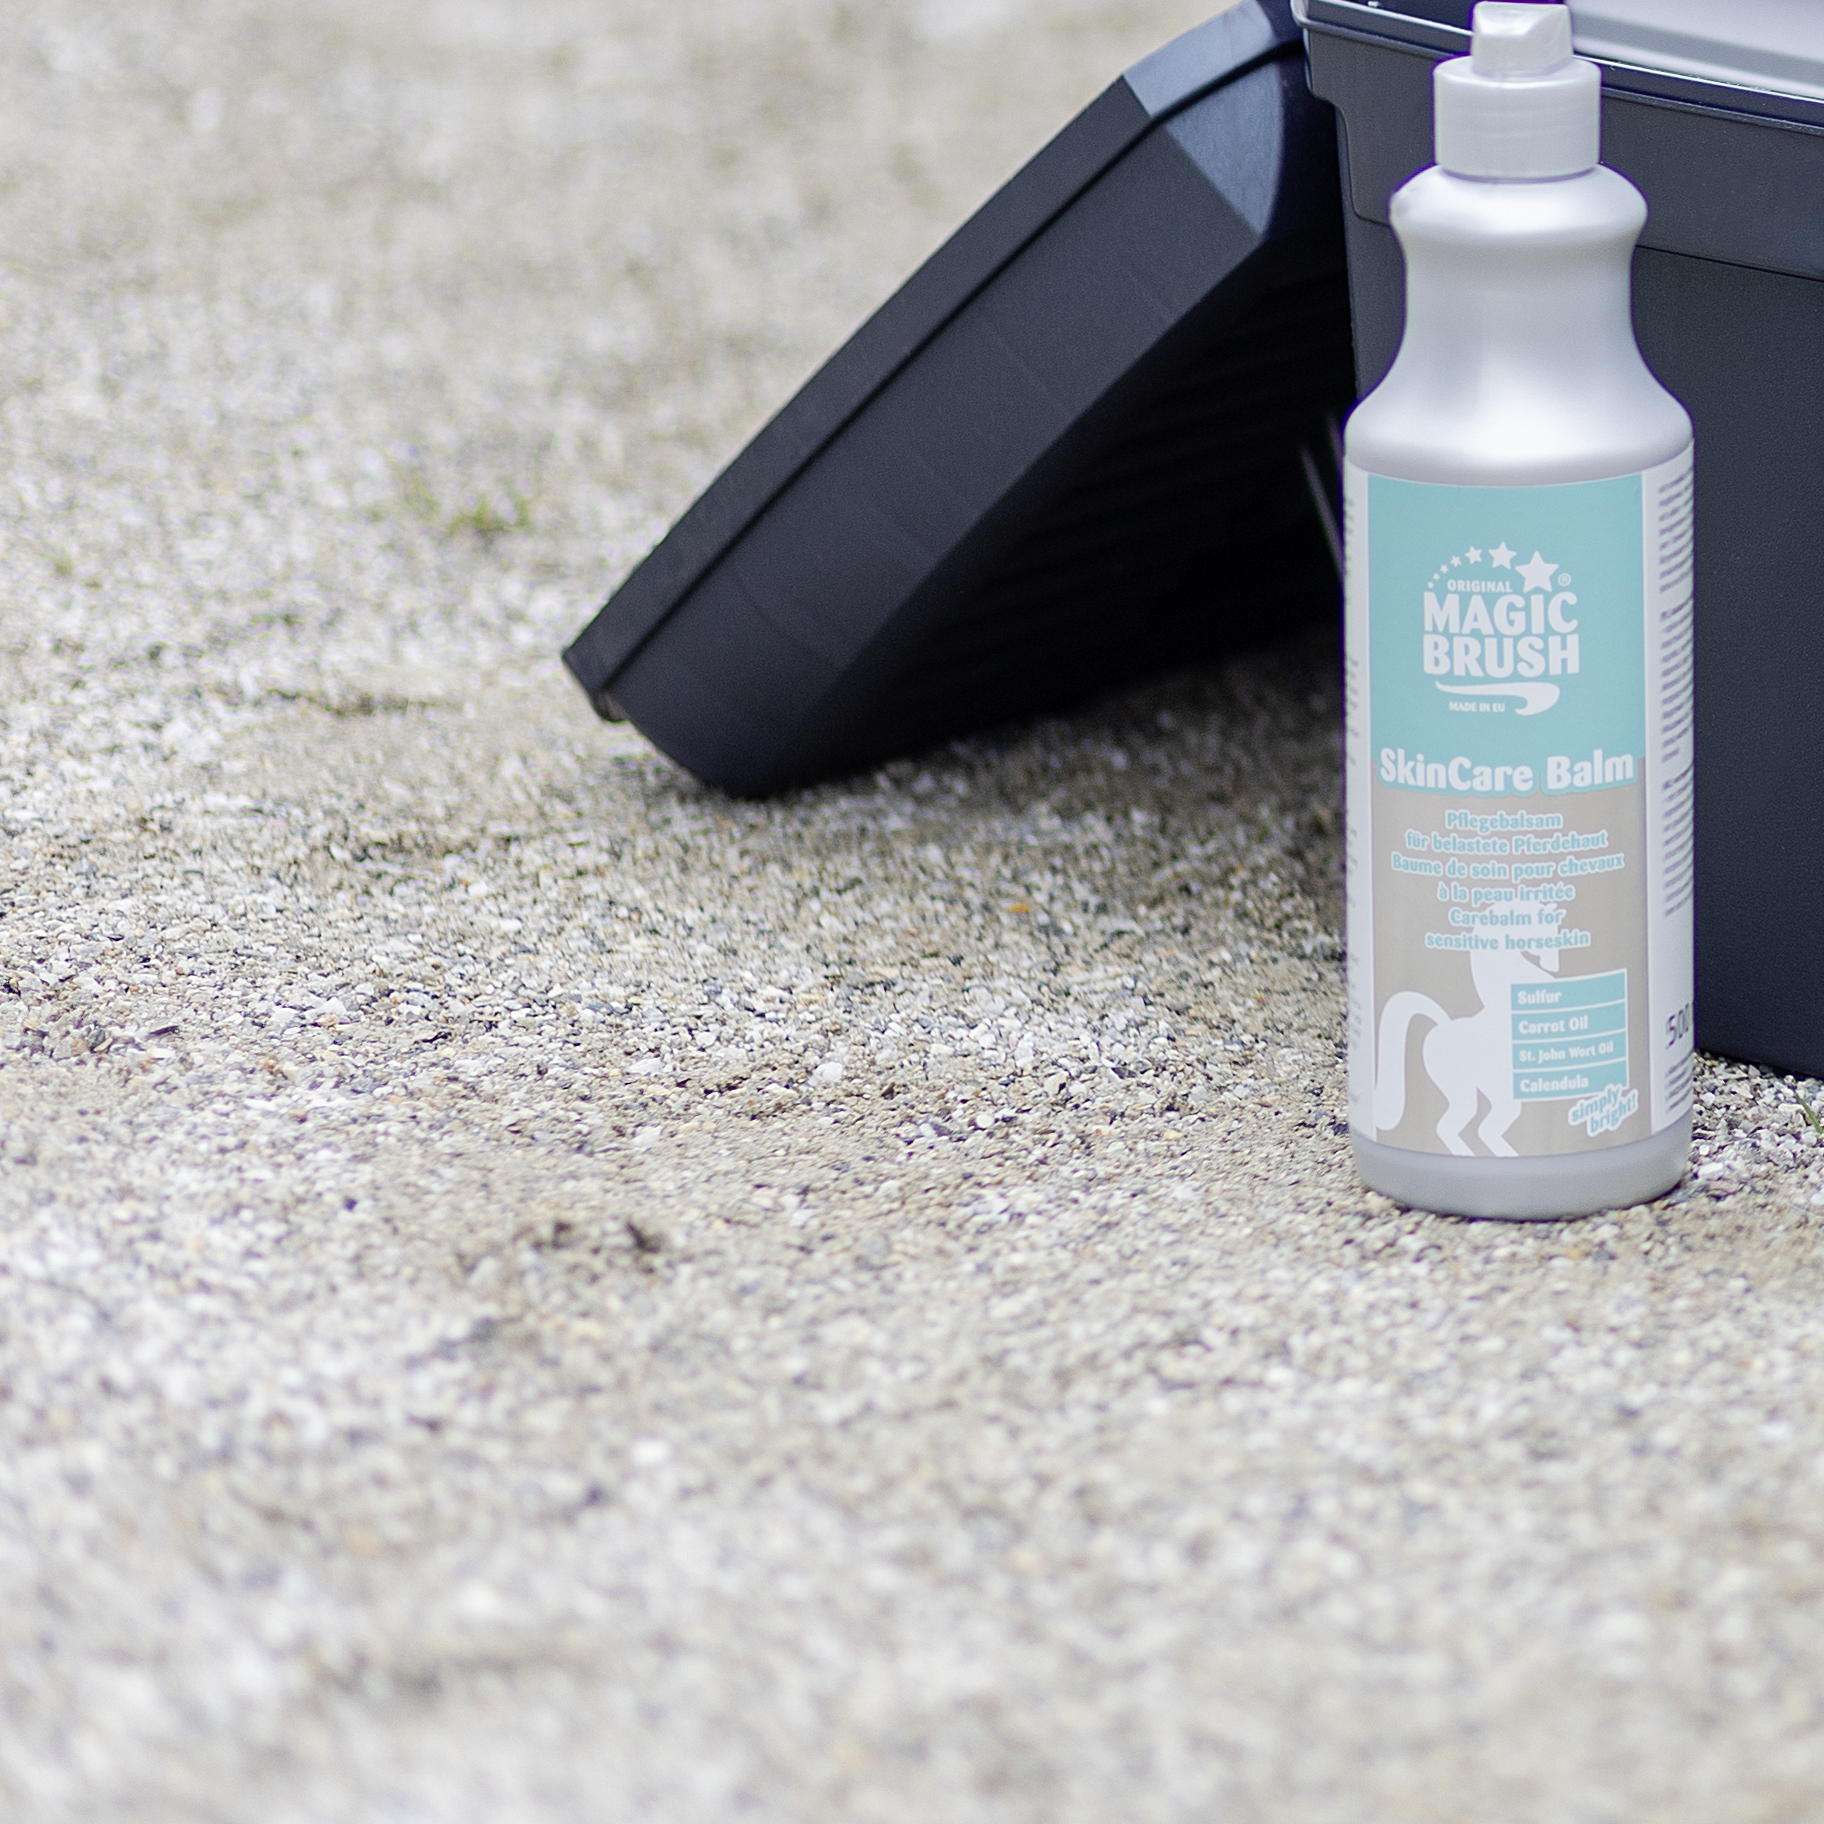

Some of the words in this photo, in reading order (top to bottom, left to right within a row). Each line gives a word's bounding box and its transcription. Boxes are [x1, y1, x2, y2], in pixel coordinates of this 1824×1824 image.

[1447, 579, 1513, 593] ORIGINAL
[1424, 591, 1578, 636] MAGIC
[1423, 633, 1580, 678] BRUSH
[1449, 701, 1477, 713] MADE
[1479, 702, 1491, 713] IN
[1492, 702, 1506, 714] EU
[1380, 747, 1534, 792] SkinCare
[1546, 748, 1634, 790] Balm
[1446, 810, 1563, 833] Pflegebalsam
[1405, 829, 1430, 850] für
[1432, 833, 1509, 854] belastete
[1512, 829, 1608, 855] Pferdehaut
[1392, 852, 1443, 876] Baume
[1447, 858, 1467, 877] de
[1471, 860, 1508, 878] soin
[1512, 860, 1555, 883] pour
[1558, 852, 1625, 876] chevaux
[1437, 882, 1449, 901] à
[1452, 882, 1468, 902] la
[1472, 886, 1515, 906] peau
[1518, 882, 1576, 902] irritée
[1449, 907, 1532, 927] Carebalm
[1537, 907, 1566, 926] for
[1425, 932, 1500, 951] sensitive
[1504, 929, 1590, 951] horseskin
[1517, 989, 1562, 1005] Sulfur
[1518, 1019, 1565, 1035] Carrot
[1568, 1015, 1589, 1031] Oil
[1519, 1049, 1535, 1062] St.
[1537, 1048, 1566, 1064] John
[1568, 1045, 1596, 1059] Wort
[1599, 1040, 1614, 1055] Oil
[1520, 1074, 1589, 1093] Calendula
[1570, 1085, 1620, 1124] simply
[1588, 1090, 1638, 1134] bright!
